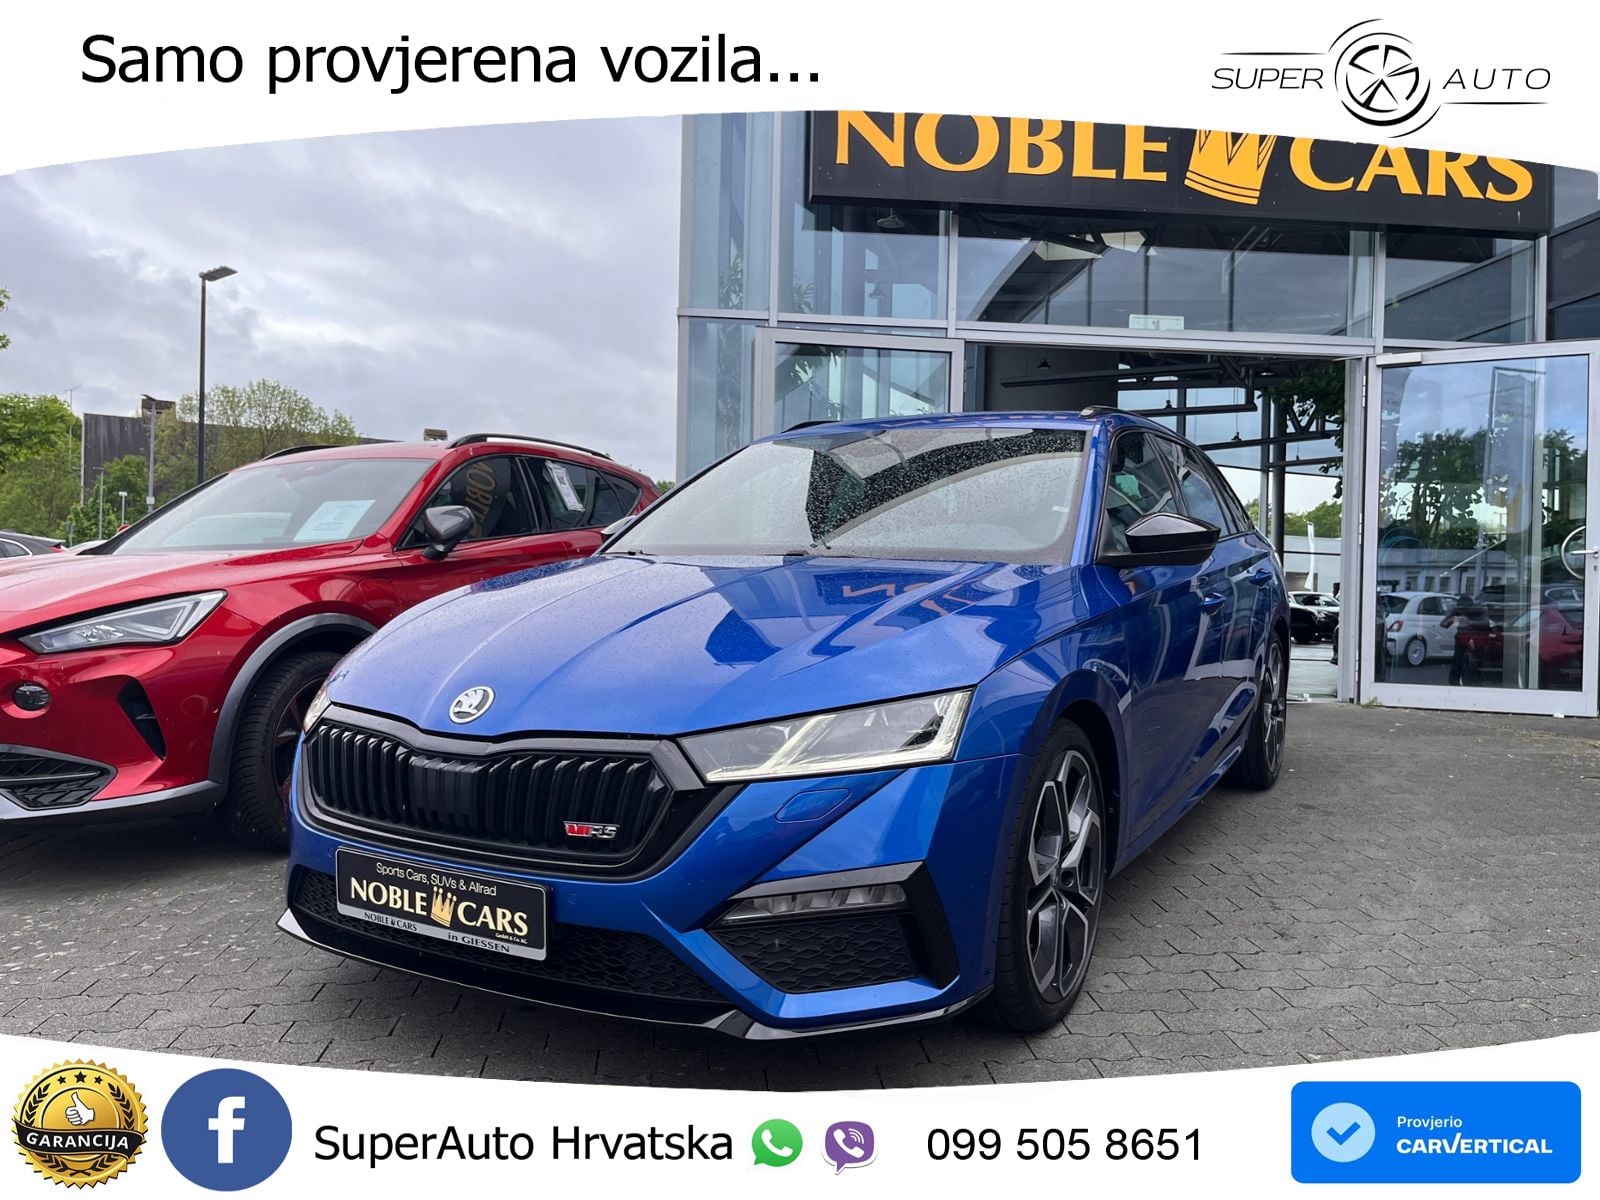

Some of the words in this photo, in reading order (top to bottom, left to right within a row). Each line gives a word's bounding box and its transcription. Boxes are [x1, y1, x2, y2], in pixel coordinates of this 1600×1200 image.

[836, 110, 1168, 182] NOBLE
[1289, 136, 1533, 202] CARS
[376, 862, 405, 878] Sports
[406, 868, 430, 885] Cars,
[430, 873, 457, 889] SUVs
[458, 879, 467, 891] &
[468, 881, 497, 897] Allrad
[350, 876, 428, 916] NOBLE
[457, 901, 529, 936] CARS
[364, 911, 389, 925] NOBLE
[396, 919, 418, 932] CARS
[447, 932, 458, 942] in
[461, 935, 510, 953] GIESSEN
